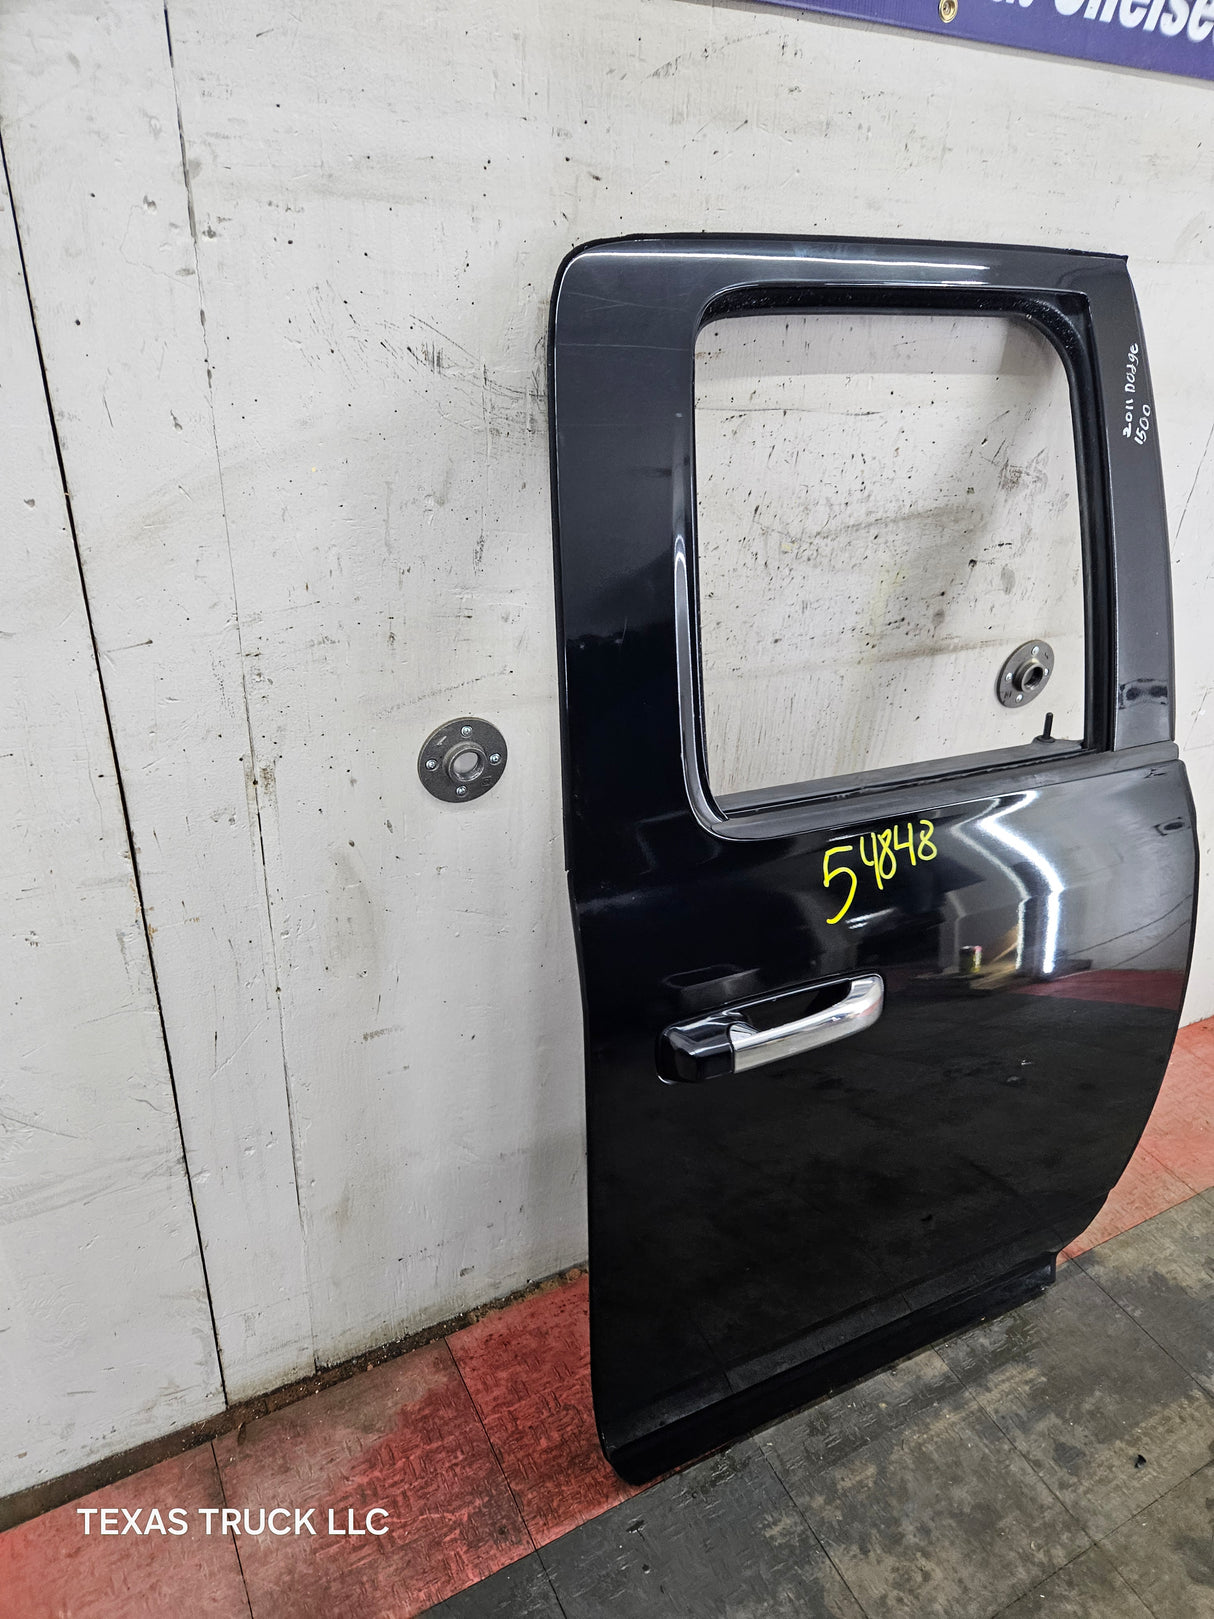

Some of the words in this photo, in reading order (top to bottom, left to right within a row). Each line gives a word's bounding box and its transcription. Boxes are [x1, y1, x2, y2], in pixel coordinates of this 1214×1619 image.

[1124, 342, 1139, 393] Dodge
[1123, 398, 1134, 438] 2011
[1134, 404, 1151, 445] 1500
[822, 819, 938, 925] 54848
